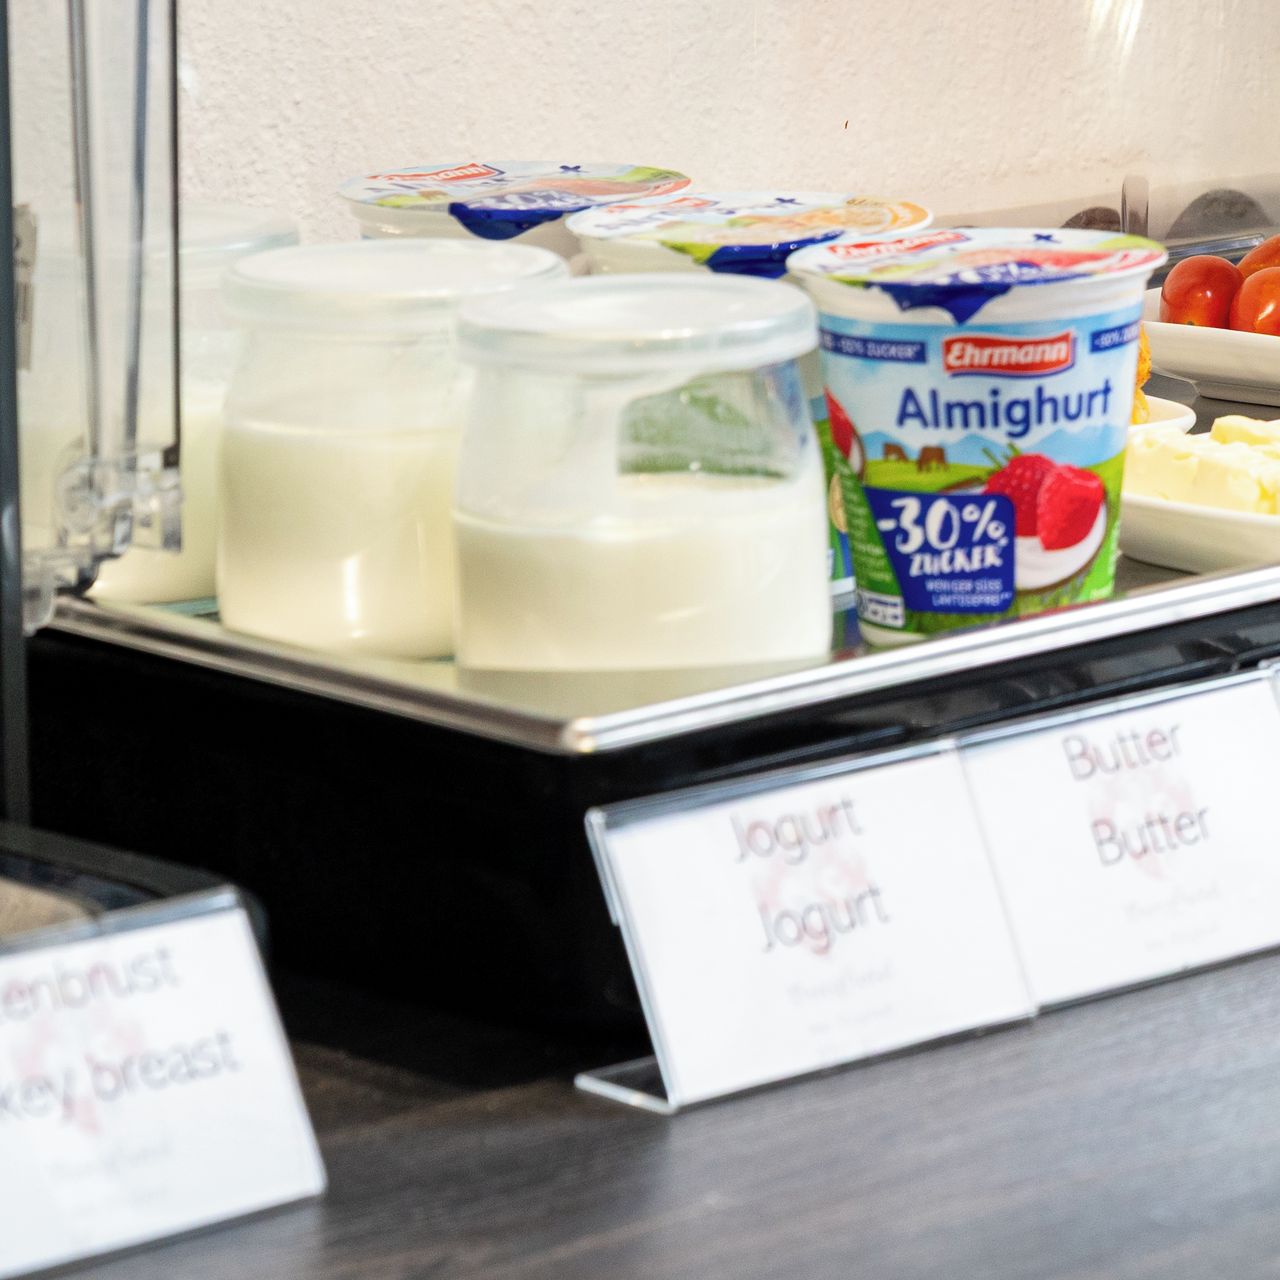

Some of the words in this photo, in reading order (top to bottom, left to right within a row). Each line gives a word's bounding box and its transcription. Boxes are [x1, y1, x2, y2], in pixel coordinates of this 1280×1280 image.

[946, 337, 1069, 368] Ehrmann
[898, 380, 1113, 439] Almighurt
[877, 496, 1007, 554] -30%
[1061, 721, 1184, 782] Butter
[730, 795, 865, 866] Jogurt
[1090, 804, 1211, 868] Butter
[760, 883, 891, 956] Jogurt
[84, 1029, 242, 1102] breast
